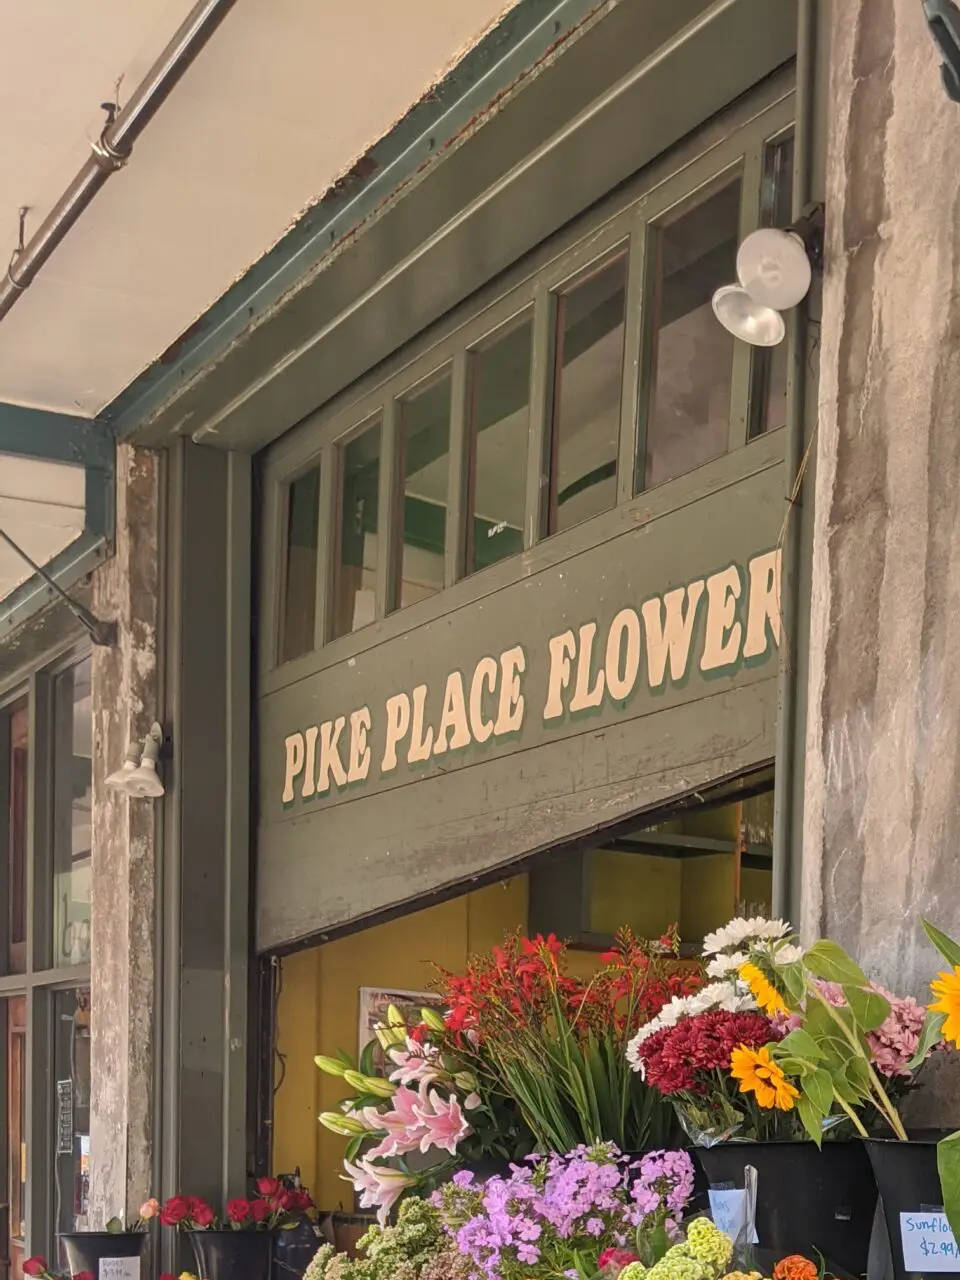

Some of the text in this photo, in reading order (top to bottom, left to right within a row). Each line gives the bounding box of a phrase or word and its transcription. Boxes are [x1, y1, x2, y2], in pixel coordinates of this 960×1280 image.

[281, 548, 783, 803] PIKE PLACE FLOWER
[906, 1217, 953, 1233] Sunflo
